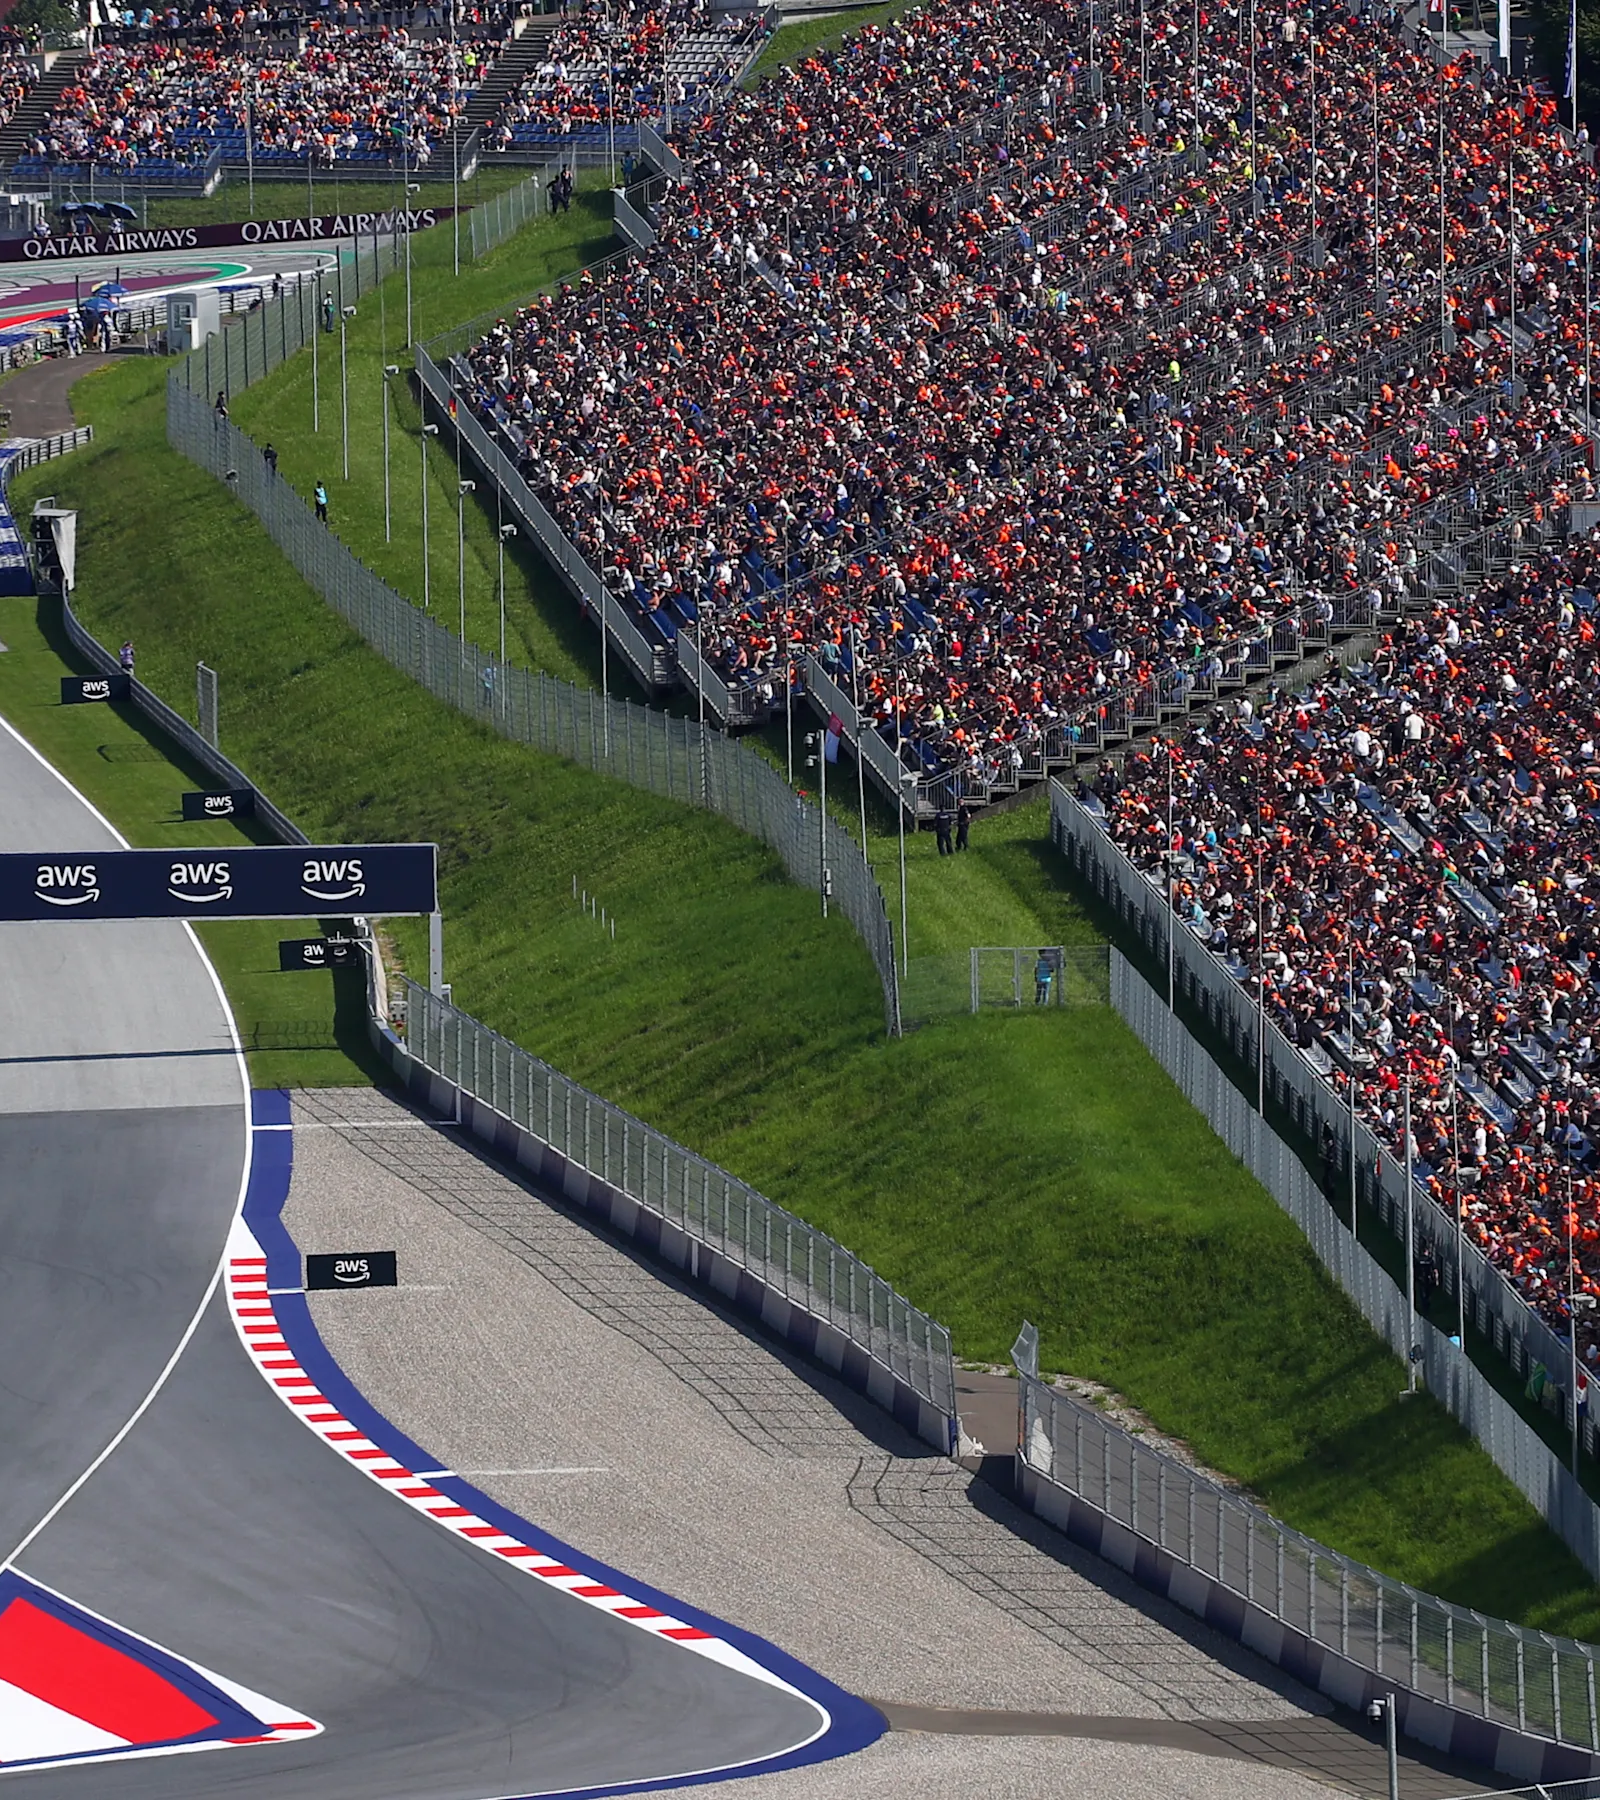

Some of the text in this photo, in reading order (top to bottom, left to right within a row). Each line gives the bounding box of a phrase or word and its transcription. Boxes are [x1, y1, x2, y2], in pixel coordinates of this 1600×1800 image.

[241, 209, 436, 243] QATAR AIRWAYS
[23, 228, 197, 260] QATAR AIRWAYS
[82, 680, 109, 692] aws
[204, 795, 232, 808] aws
[36, 865, 97, 888] aws
[169, 862, 231, 886] aws
[302, 859, 363, 883] aws
[303, 944, 324, 957] aw
[335, 1259, 369, 1273] aws
